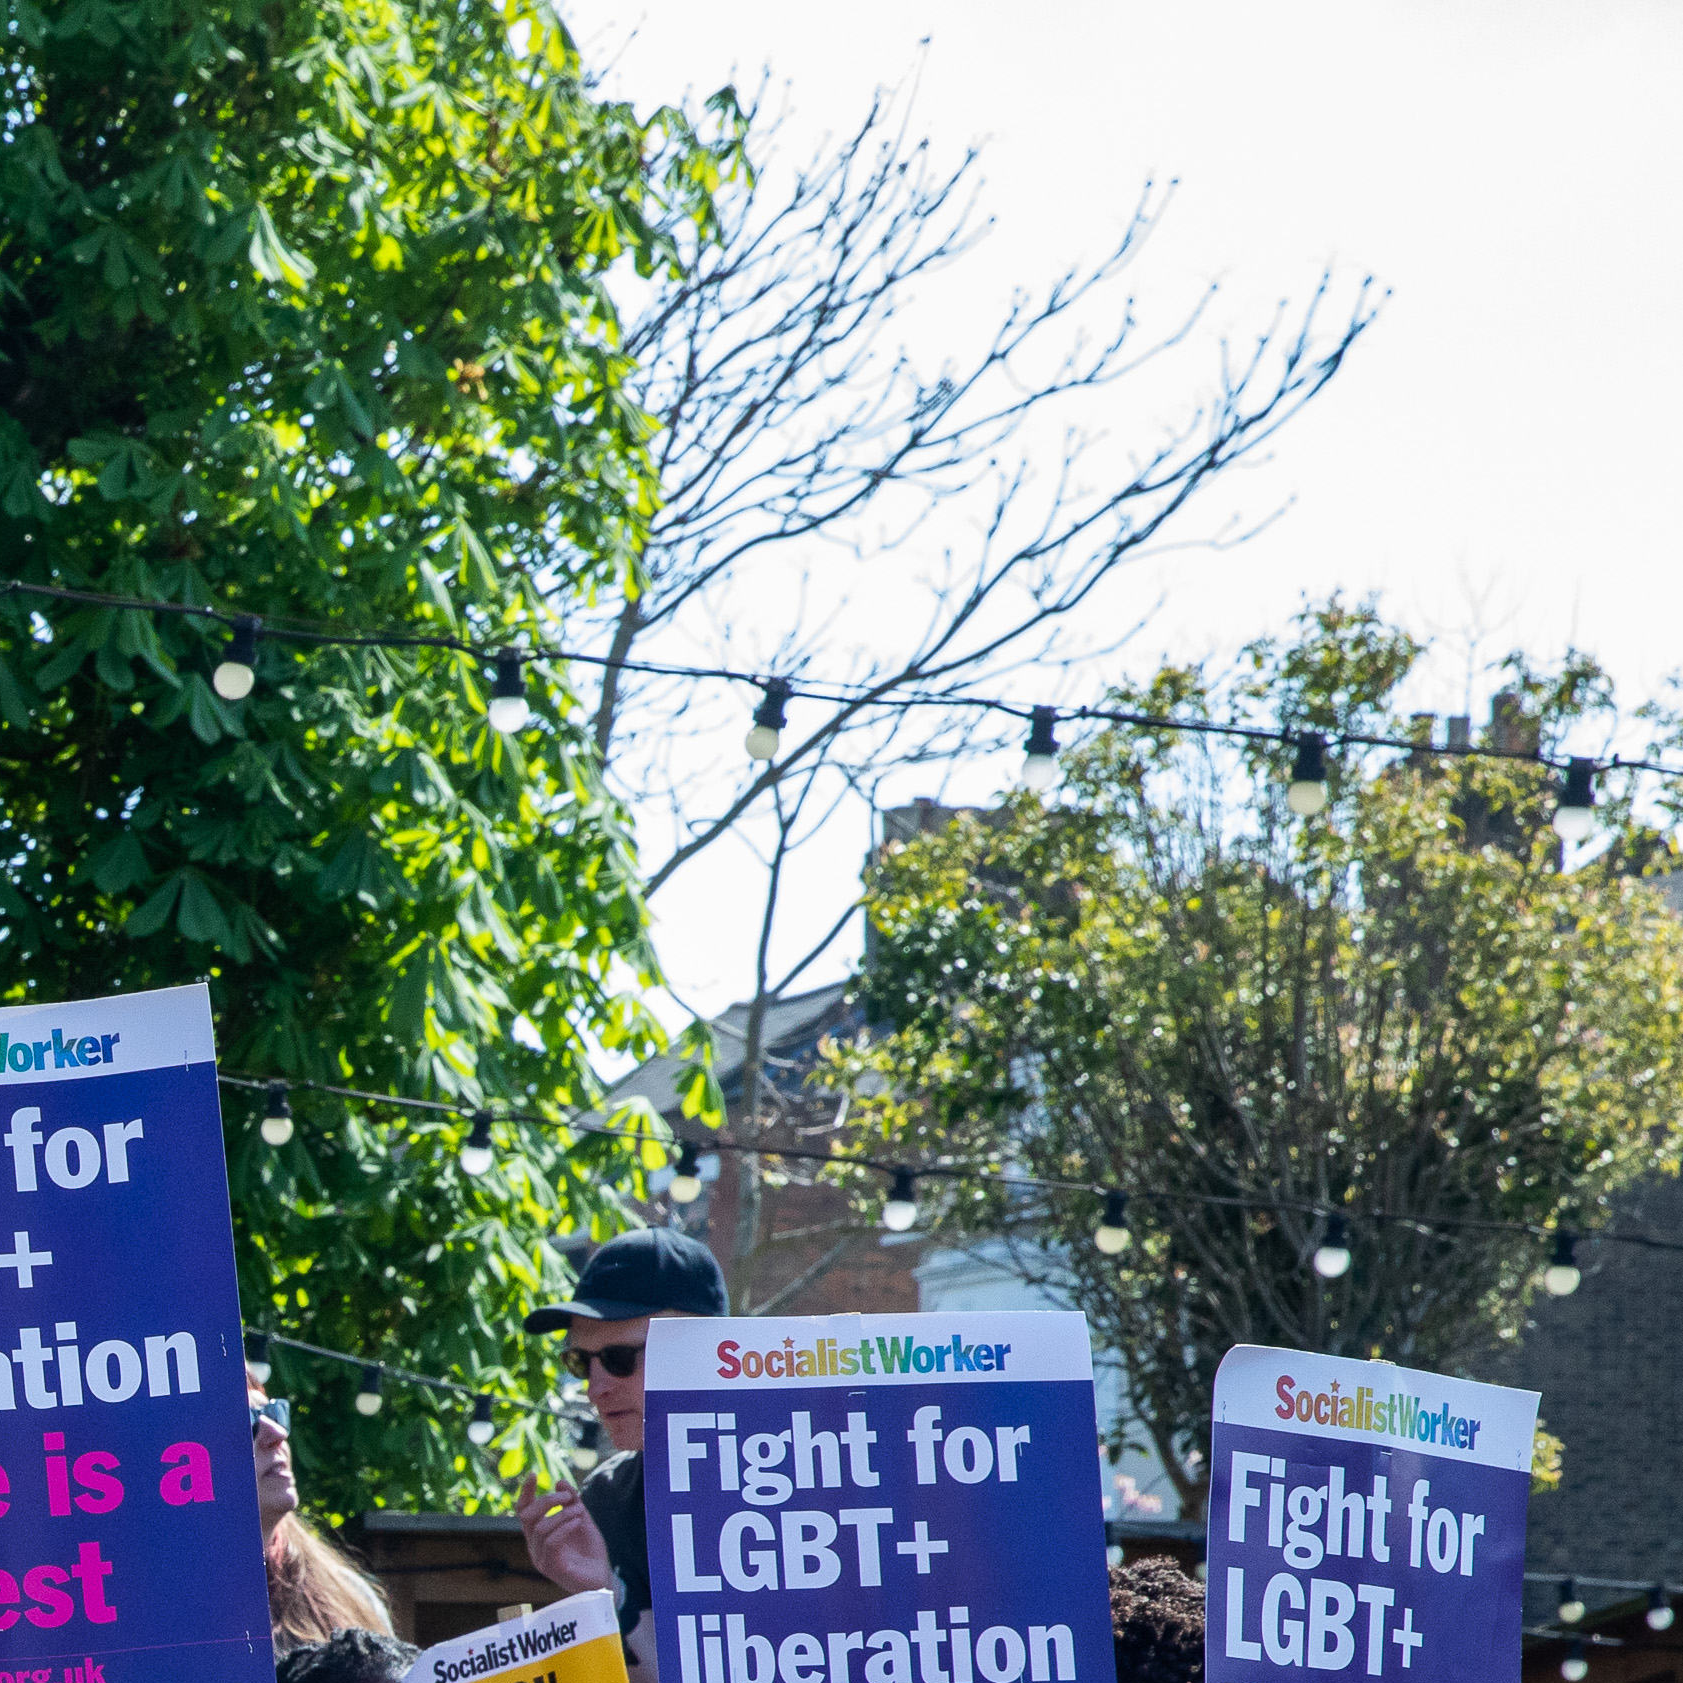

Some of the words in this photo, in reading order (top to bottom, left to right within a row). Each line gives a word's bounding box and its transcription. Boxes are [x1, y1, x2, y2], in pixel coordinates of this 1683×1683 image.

[4, 1107, 143, 1192] for
[43, 1432, 125, 1518] is
[159, 1440, 216, 1506] a
[668, 1411, 879, 1505] Fight
[907, 1406, 1030, 1484] for
[671, 1508, 948, 1592] LGBT+
[1229, 1451, 1391, 1569] Fight
[1408, 1479, 1484, 1576] for
[1226, 1567, 1422, 1676] LGBT+
